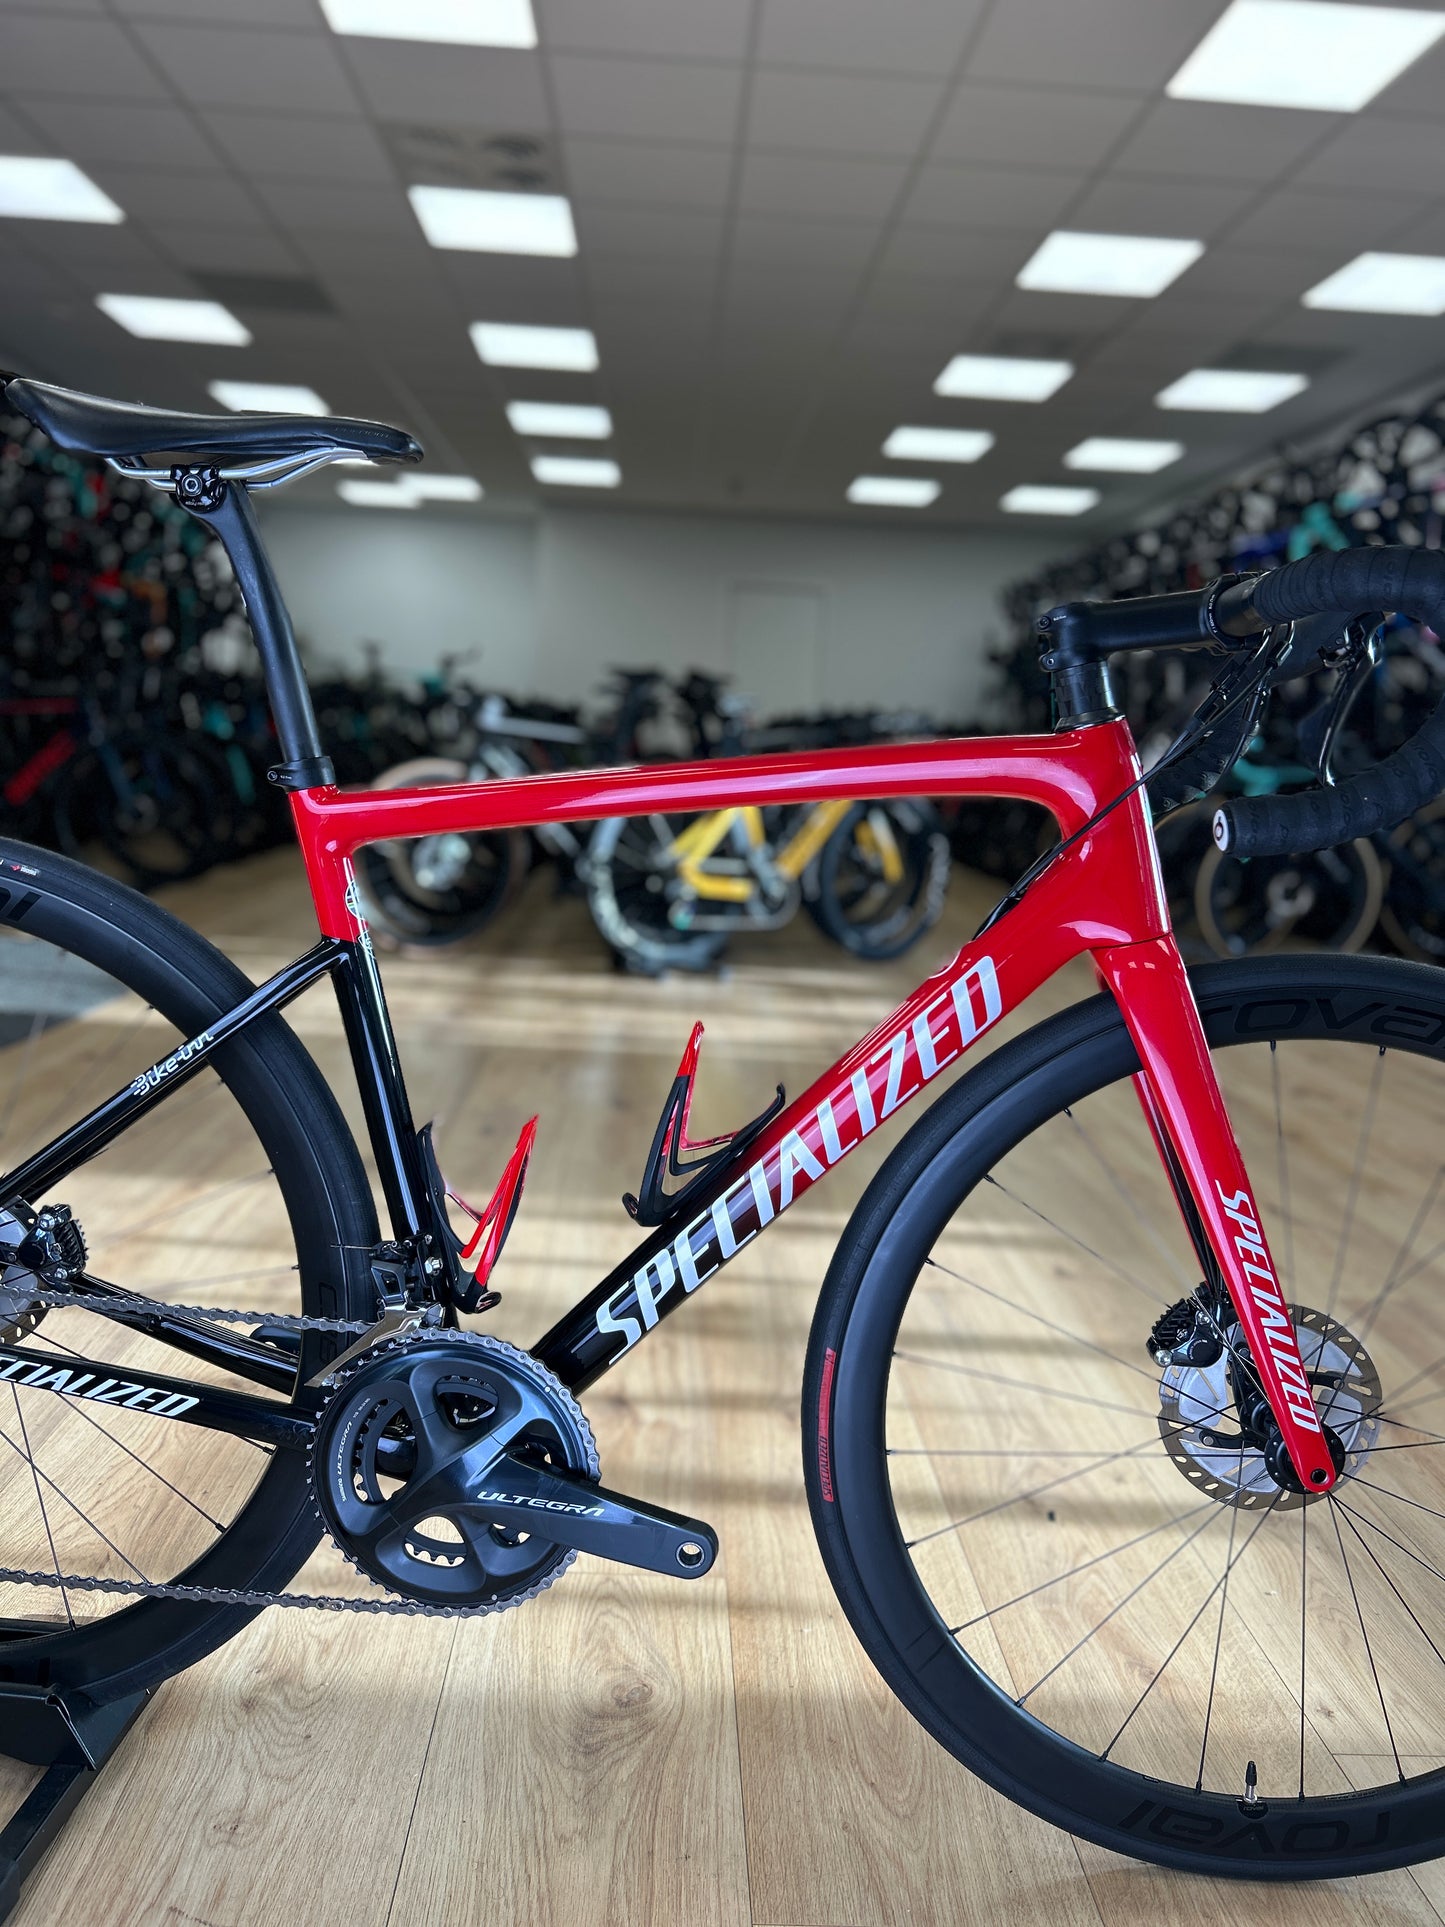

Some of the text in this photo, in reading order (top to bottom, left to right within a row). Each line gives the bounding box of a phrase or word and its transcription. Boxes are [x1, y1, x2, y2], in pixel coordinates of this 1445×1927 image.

[1201, 998, 1445, 1048] rova
[596, 955, 1003, 1365] SPECIALIZED
[1215, 1179, 1320, 1434] SPECIALIZED
[337, 1421, 353, 1475] ULTEGRA
[819, 1436, 833, 1497] SPECIALIZED
[477, 1491, 605, 1517] ULTEGRA
[1117, 1799, 1391, 1854] roval
